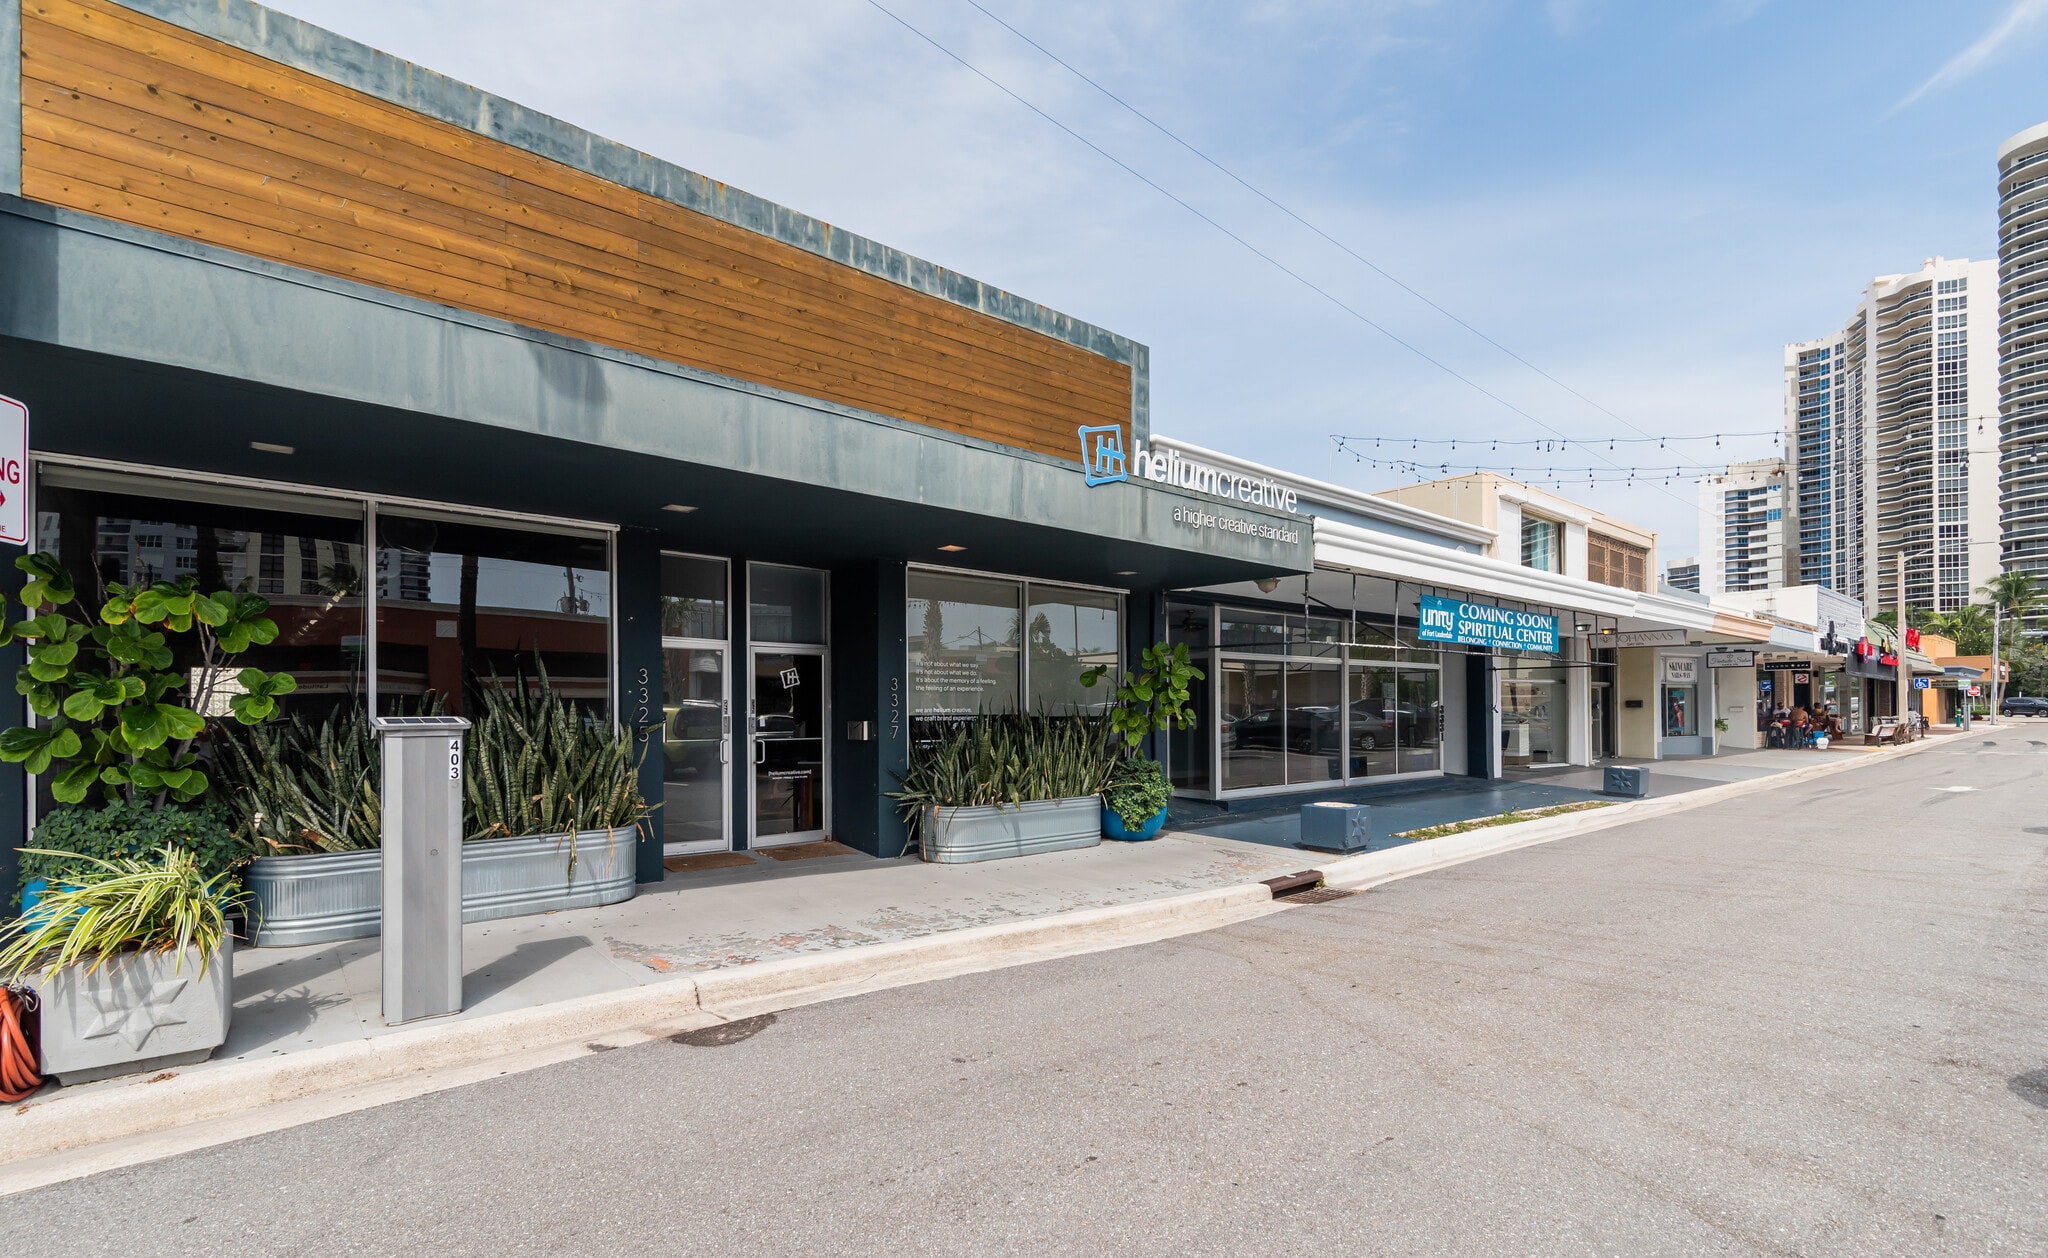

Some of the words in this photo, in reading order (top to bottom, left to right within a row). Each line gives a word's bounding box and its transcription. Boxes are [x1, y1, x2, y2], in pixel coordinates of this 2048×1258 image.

[1133, 439, 1297, 514] heliumcreative
[1173, 507, 1181, 521] a
[1183, 506, 1217, 529] higher
[1218, 516, 1257, 536] creative
[1259, 524, 1298, 544] standard
[1458, 620, 1514, 640] SPIRITUAL
[1516, 628, 1553, 645] CENTER
[1459, 603, 1514, 625] COMING
[1516, 612, 1553, 630] SOON!
[1457, 635, 1487, 645] BELONGING
[1492, 639, 1523, 649] CONNECTION
[1526, 643, 1553, 652] COMMUNITY
[890, 677, 899, 739] 3327
[450, 740, 459, 779] 403
